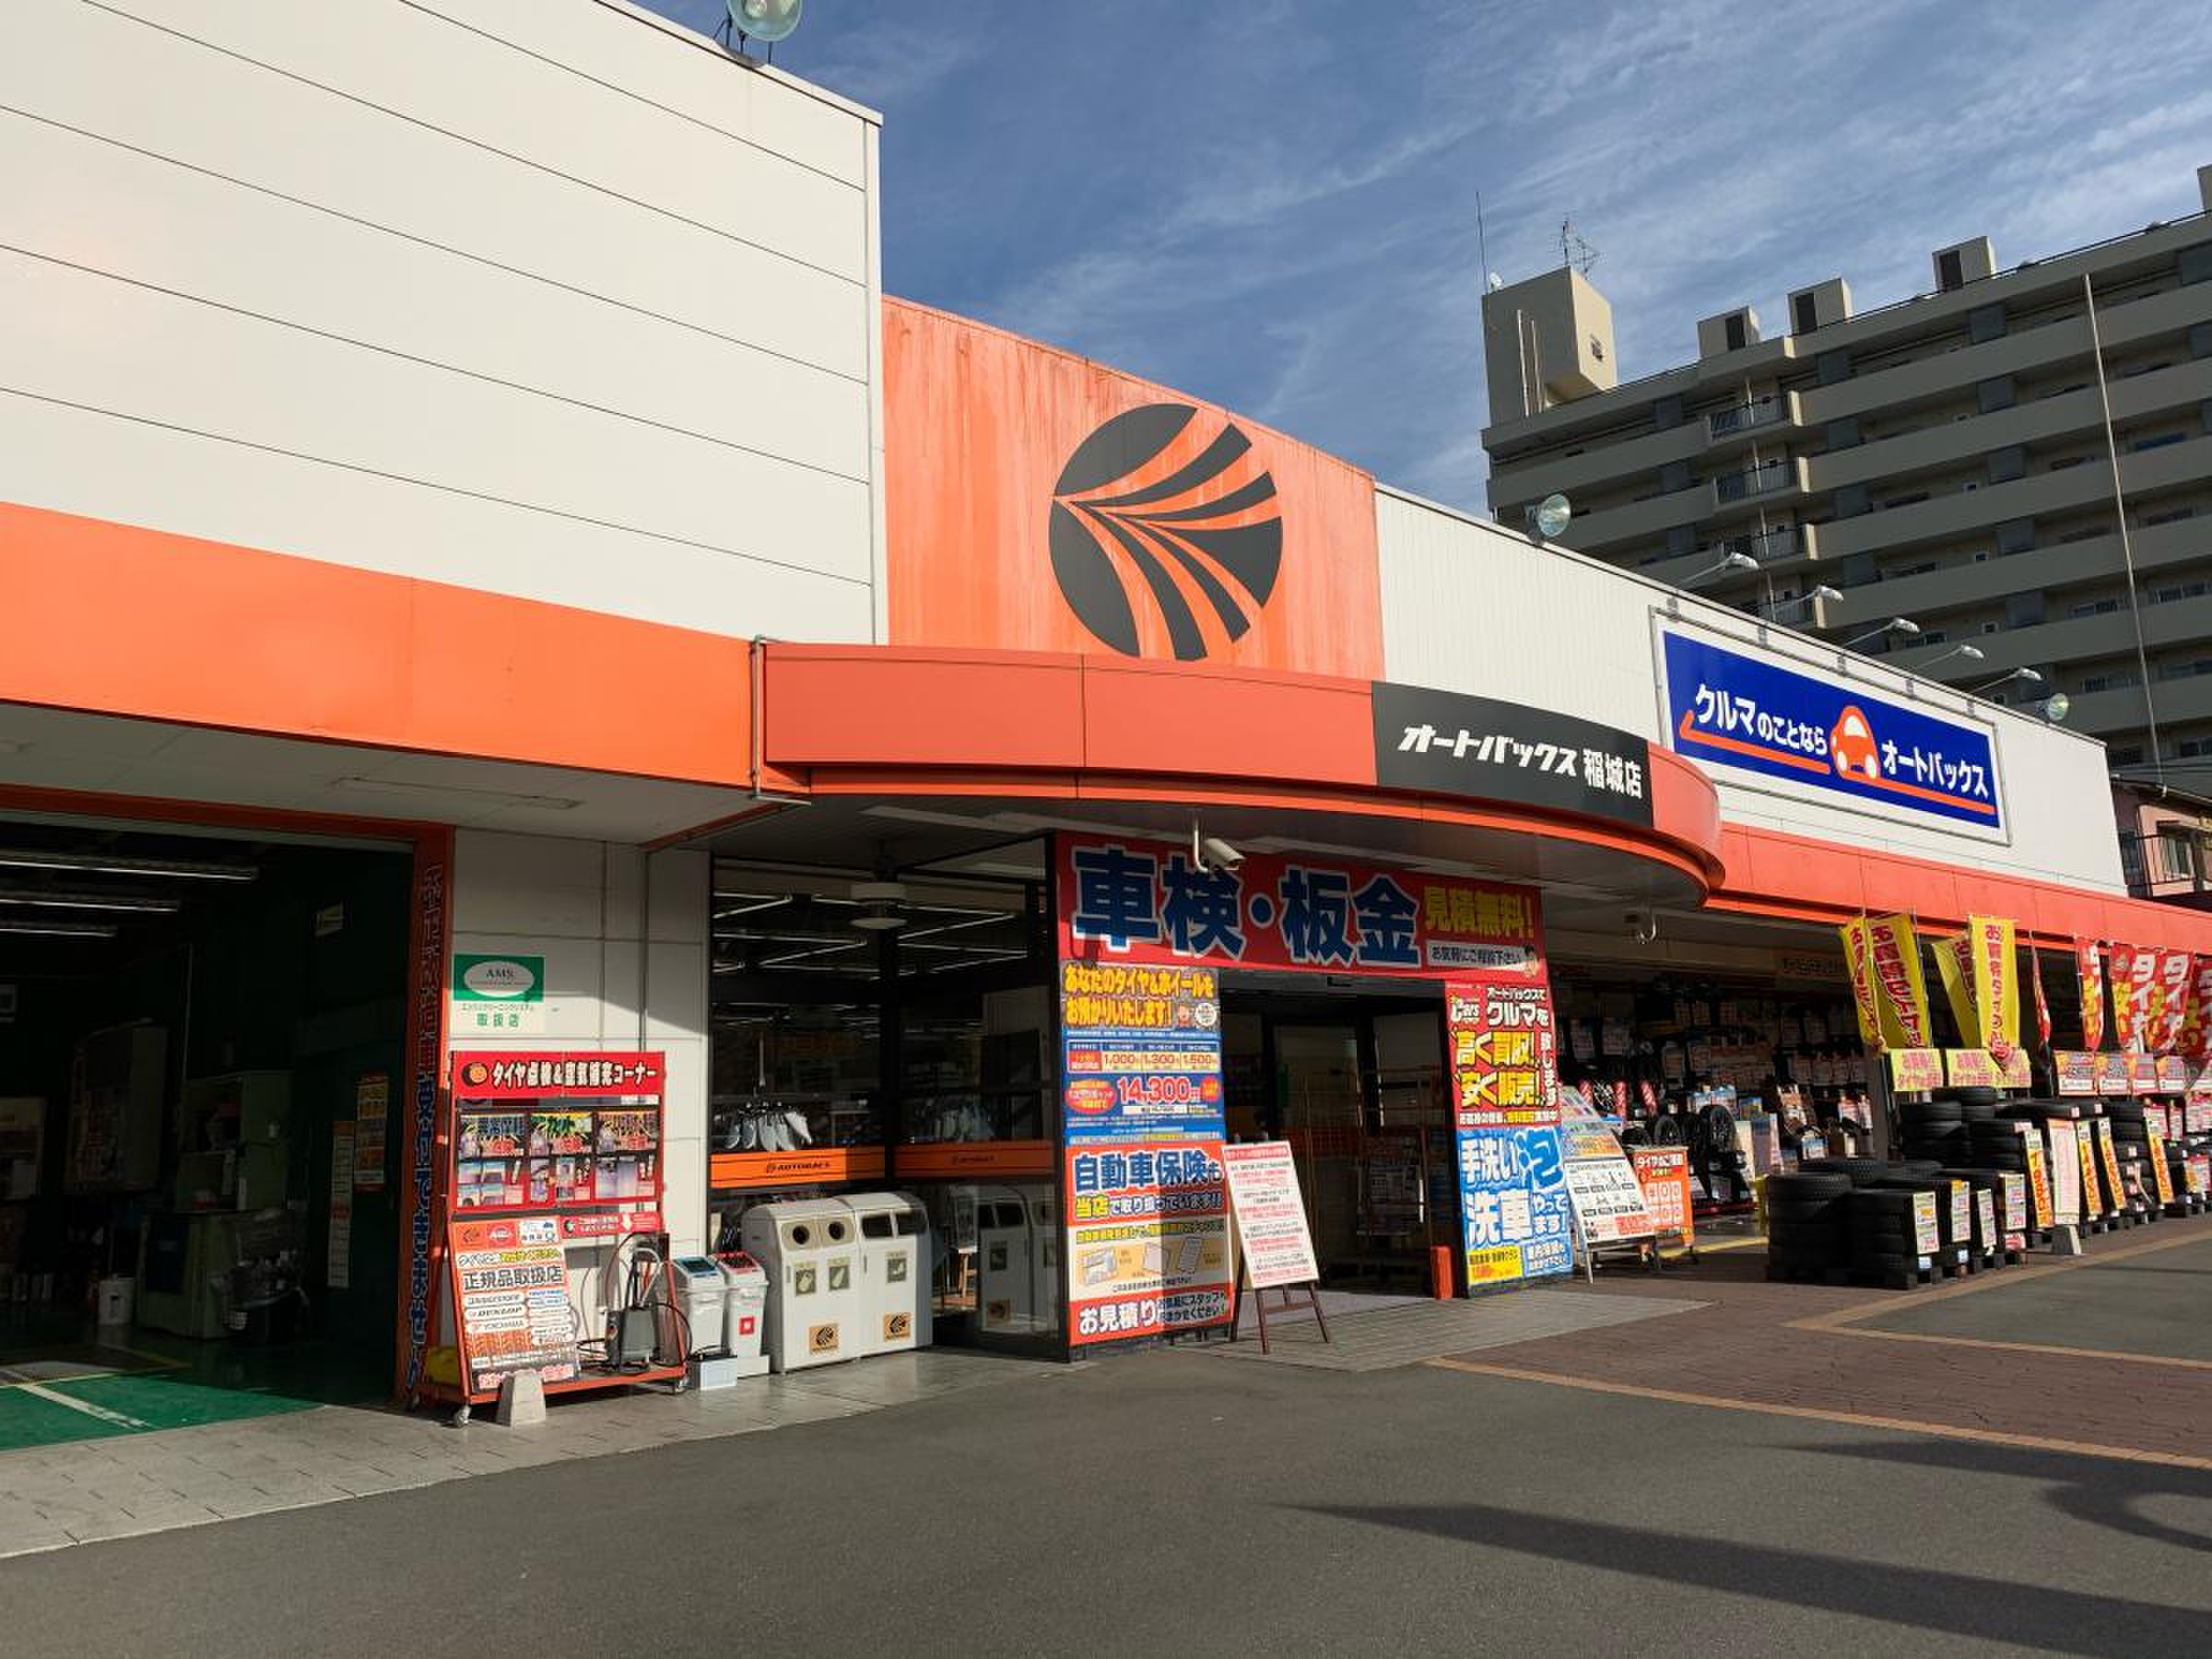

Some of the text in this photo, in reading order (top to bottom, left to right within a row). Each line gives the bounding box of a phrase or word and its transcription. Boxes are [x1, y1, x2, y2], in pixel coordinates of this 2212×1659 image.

[1695, 684, 1829, 755] クルマのことなら
[1397, 724, 1642, 798] オートバックス 稲城店
[1881, 740, 1989, 798] オートバックス
[1072, 844, 1421, 968] 車検・板金
[477, 1013, 520, 1028] 取扱店
[1487, 1001, 1549, 1029] クルマを
[1074, 1149, 1224, 1193] 自動車保険も
[1460, 1137, 1519, 1185] 手洗い
[1465, 1188, 1535, 1246] 洗車
[463, 1264, 566, 1291] 正規品取扱店
[1079, 1298, 1158, 1335] お見積り
